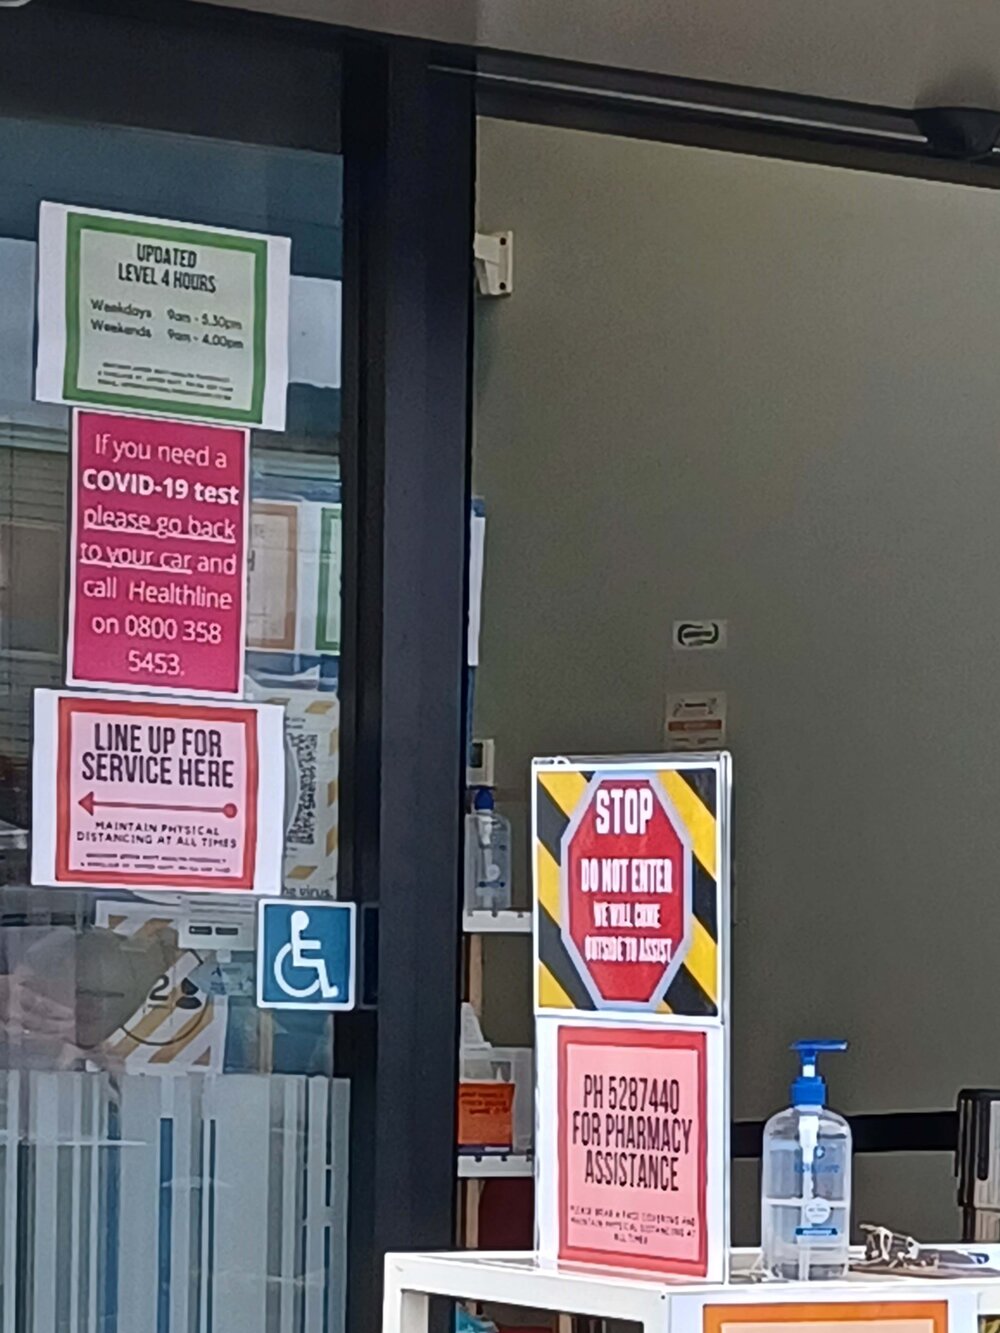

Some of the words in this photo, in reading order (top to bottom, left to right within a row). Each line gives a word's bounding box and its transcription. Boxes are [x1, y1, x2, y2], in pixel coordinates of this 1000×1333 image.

[137, 243, 198, 268] UPDATED
[118, 262, 158, 286] LEVEL
[161, 269, 170, 289] 4
[173, 271, 217, 293] HOURS
[90, 299, 152, 320] Weekdays
[167, 308, 191, 324] 9am
[90, 319, 152, 339] Weekends
[167, 328, 191, 343] 9am
[201, 333, 244, 350] 4.00pm
[95, 434, 110, 455] If
[113, 444, 151, 463] you
[158, 445, 210, 467] need
[214, 452, 228, 469] a
[82, 468, 188, 499] COVID-19
[194, 482, 240, 506] test
[83, 504, 151, 531] please
[156, 516, 183, 539] go
[187, 515, 237, 543] back
[80, 542, 103, 562] to
[107, 550, 153, 569] your
[159, 552, 193, 571] car
[197, 552, 237, 575] and
[83, 576, 118, 599] call
[128, 580, 233, 610] Healthline
[91, 616, 119, 635] on
[125, 615, 178, 641] 0800
[182, 620, 222, 644] 358
[127, 650, 185, 677] 5453.
[93, 722, 141, 753] LINE
[148, 726, 175, 755] UP
[181, 728, 222, 759] FOR
[81, 751, 172, 786] SERVICE
[178, 757, 234, 789] HERE
[595, 787, 654, 835] STOP
[76, 831, 153, 845] DISTANCING
[156, 835, 172, 846] AT
[176, 836, 198, 848] ALL
[201, 837, 237, 849] TIMES
[94, 821, 157, 833] MAINTAIN
[160, 823, 220, 837] PHYSICAL
[580, 858, 600, 893] DO
[601, 858, 630, 893] NOT
[630, 858, 674, 894] ENTER
[593, 900, 609, 928] WE
[609, 902, 634, 929] WILL
[634, 902, 662, 930] COME
[584, 934, 625, 963] OUTSIDE
[638, 937, 673, 965] ASSIST
[582, 1073, 604, 1109] PH
[608, 1076, 680, 1116] 5287440
[572, 1111, 602, 1147] FOR
[604, 1113, 693, 1155] PHARMACY
[584, 1149, 679, 1192] ASSISTANCE
